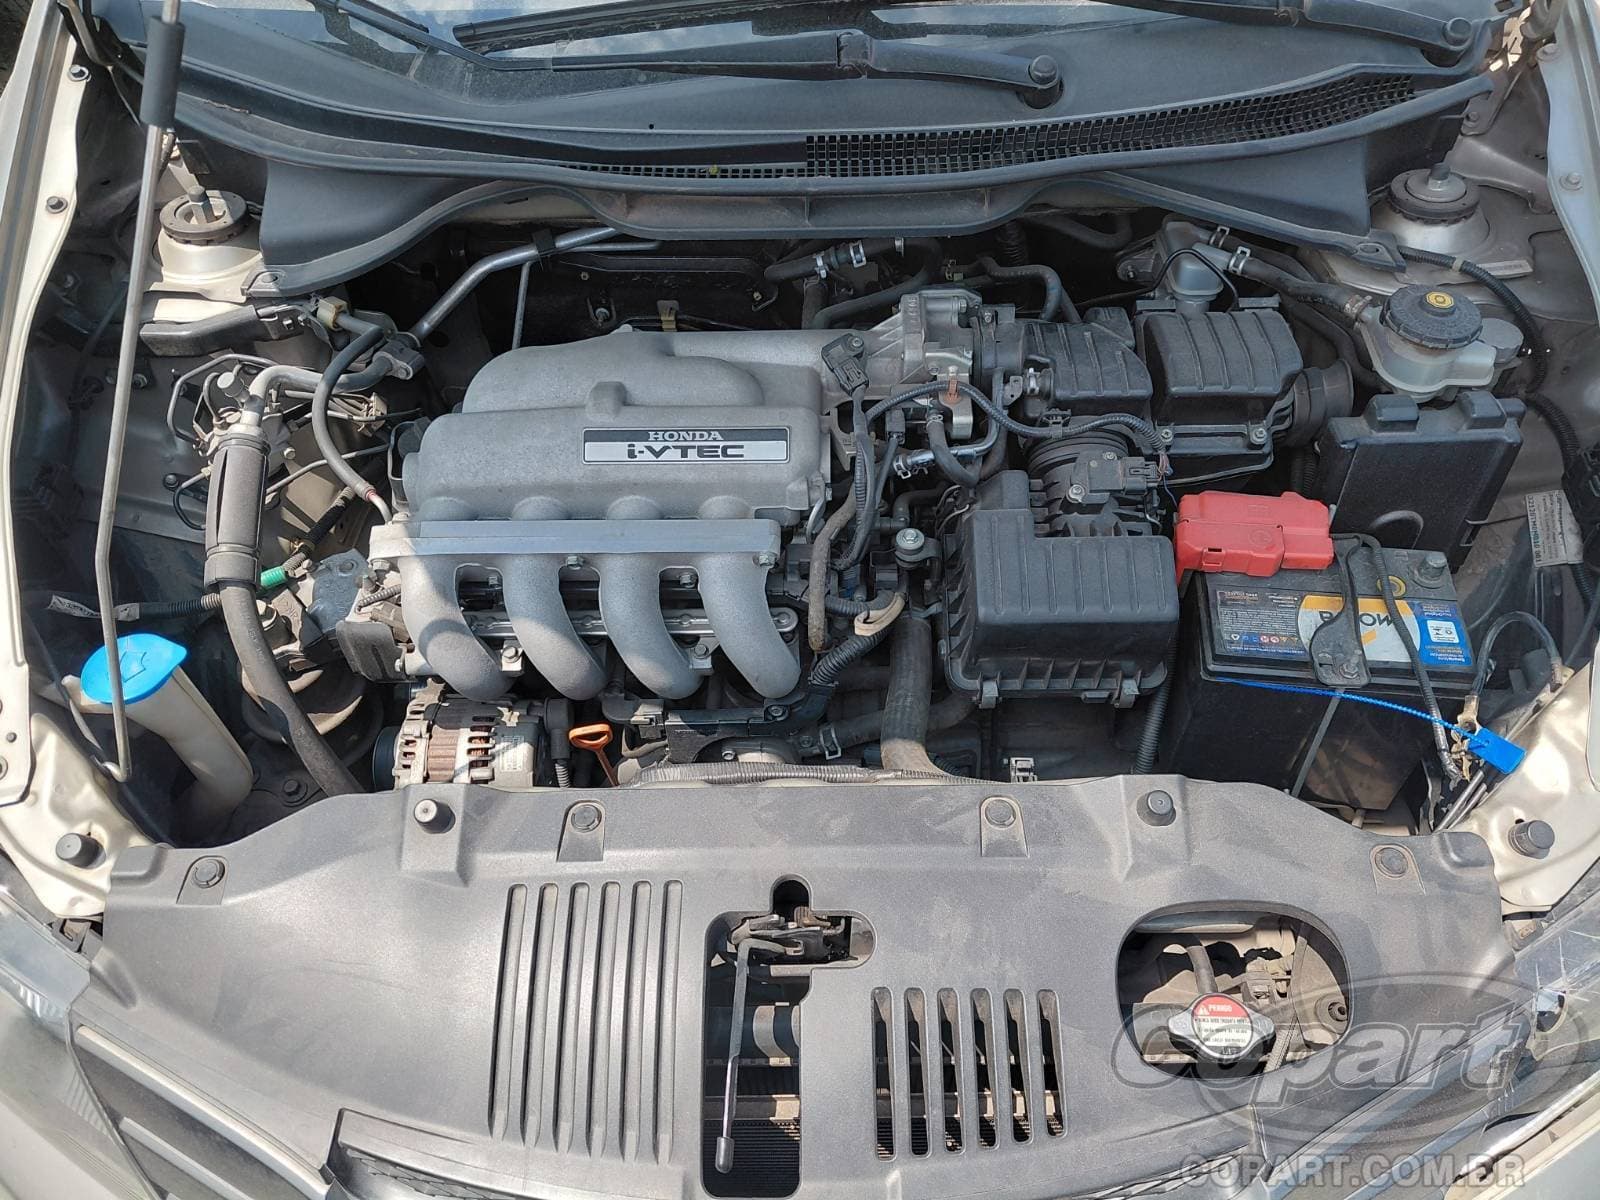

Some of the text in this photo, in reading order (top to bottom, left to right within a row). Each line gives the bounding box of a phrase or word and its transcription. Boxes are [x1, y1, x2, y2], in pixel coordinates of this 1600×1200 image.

[648, 431, 724, 441] HONDA
[627, 444, 745, 459] i-VTEC
[1208, 1004, 1232, 1012] PERIGO
